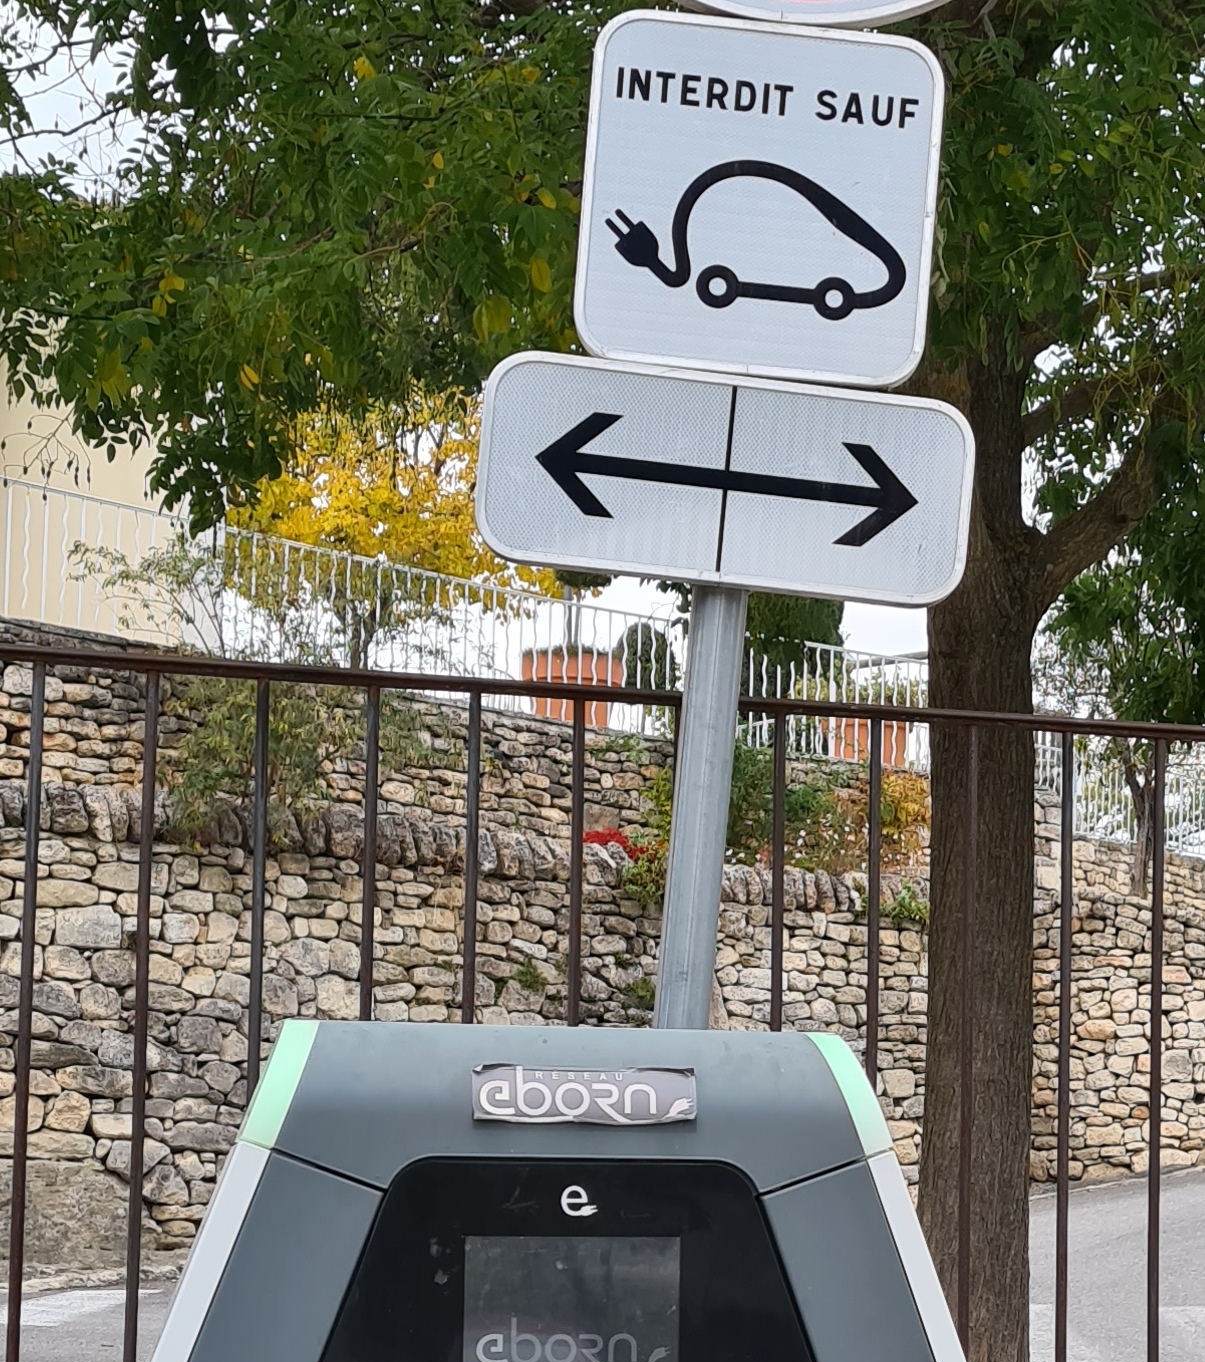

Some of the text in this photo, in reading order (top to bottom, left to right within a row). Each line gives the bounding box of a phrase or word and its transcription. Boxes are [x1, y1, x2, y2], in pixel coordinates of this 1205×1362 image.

[616, 67, 920, 128] INTERDIT SAUF
[479, 1066, 670, 1124] eborn
